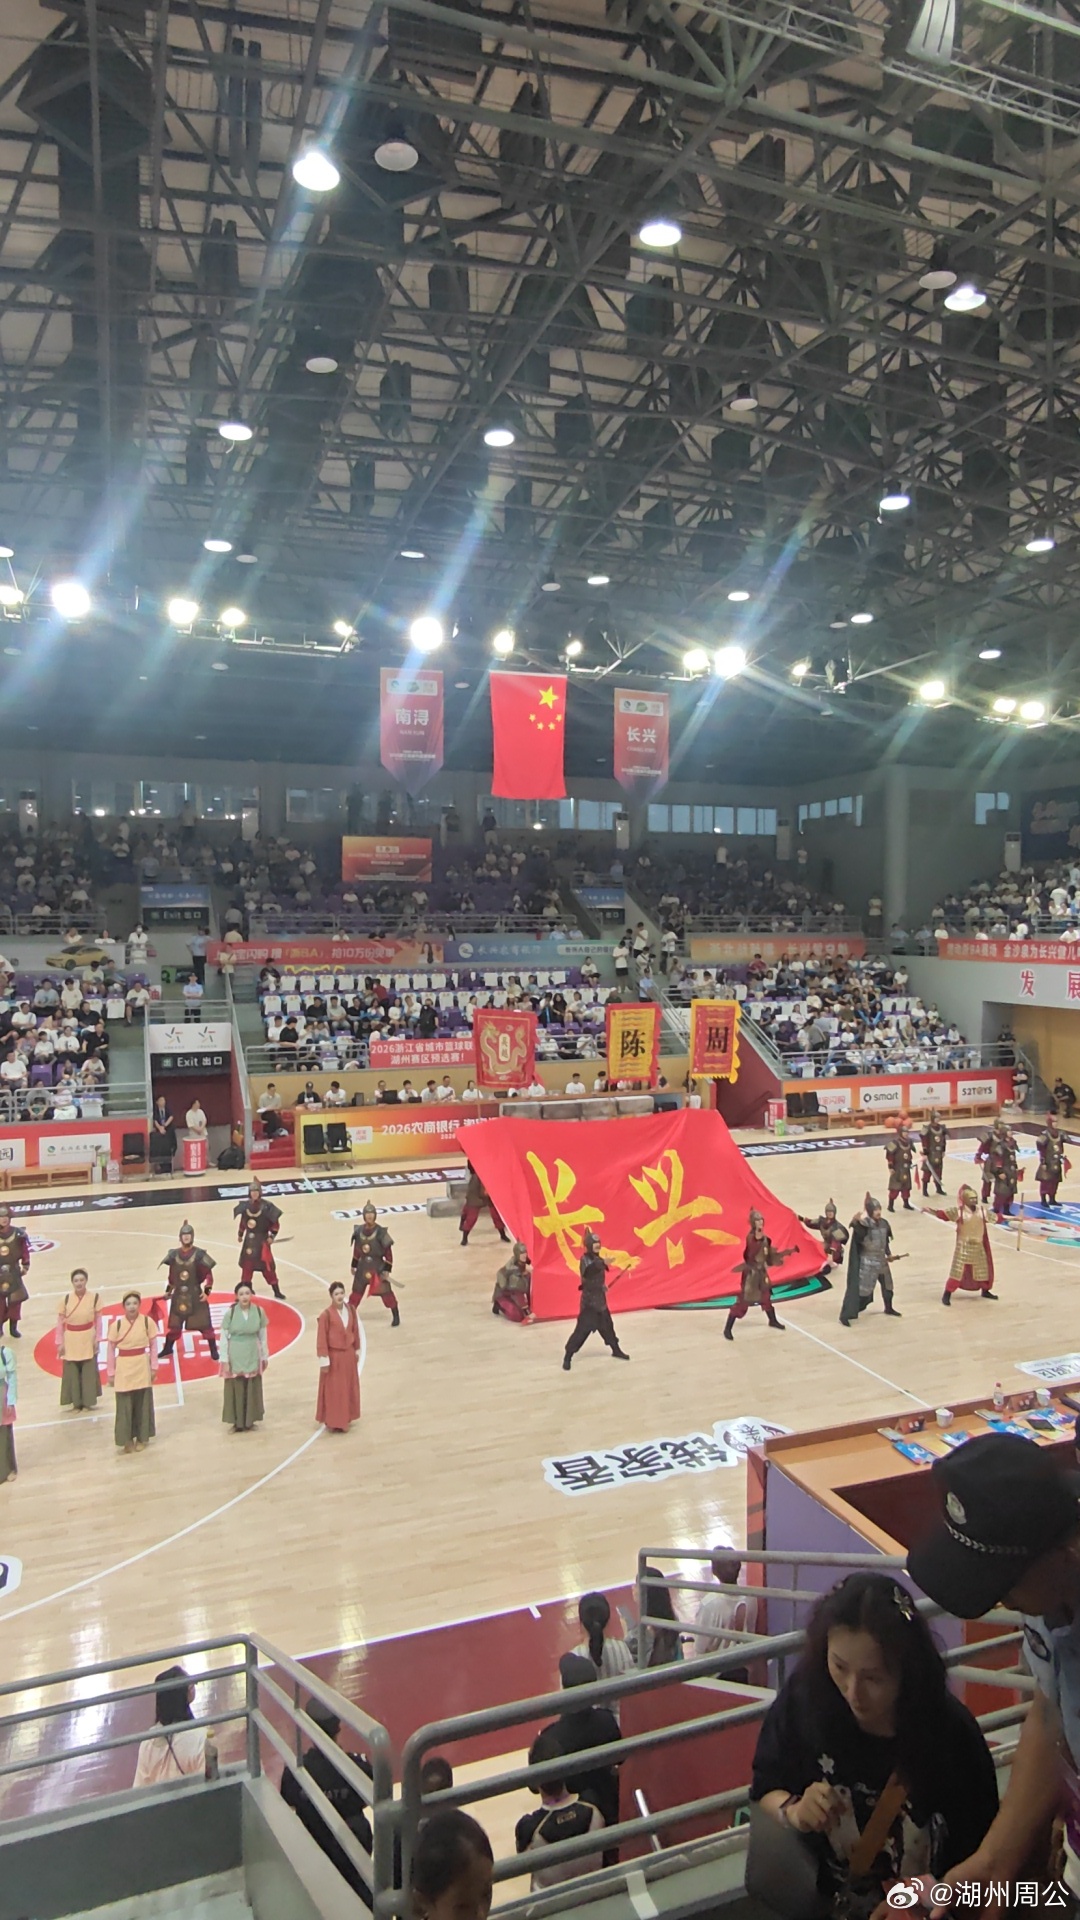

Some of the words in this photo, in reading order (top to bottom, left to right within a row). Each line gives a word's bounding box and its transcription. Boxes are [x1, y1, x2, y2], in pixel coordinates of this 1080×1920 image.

[395, 708, 429, 725] 南浔
[627, 726, 657, 743] 长兴
[620, 1029, 646, 1058] 陈
[707, 1026, 729, 1053] 周
[177, 1057, 198, 1067] Exit
[202, 1056, 222, 1066] 出口
[873, 1091, 899, 1102] smart
[381, 1119, 460, 1136] 2026农商银行
[552, 1436, 730, 1490] 钱家香
